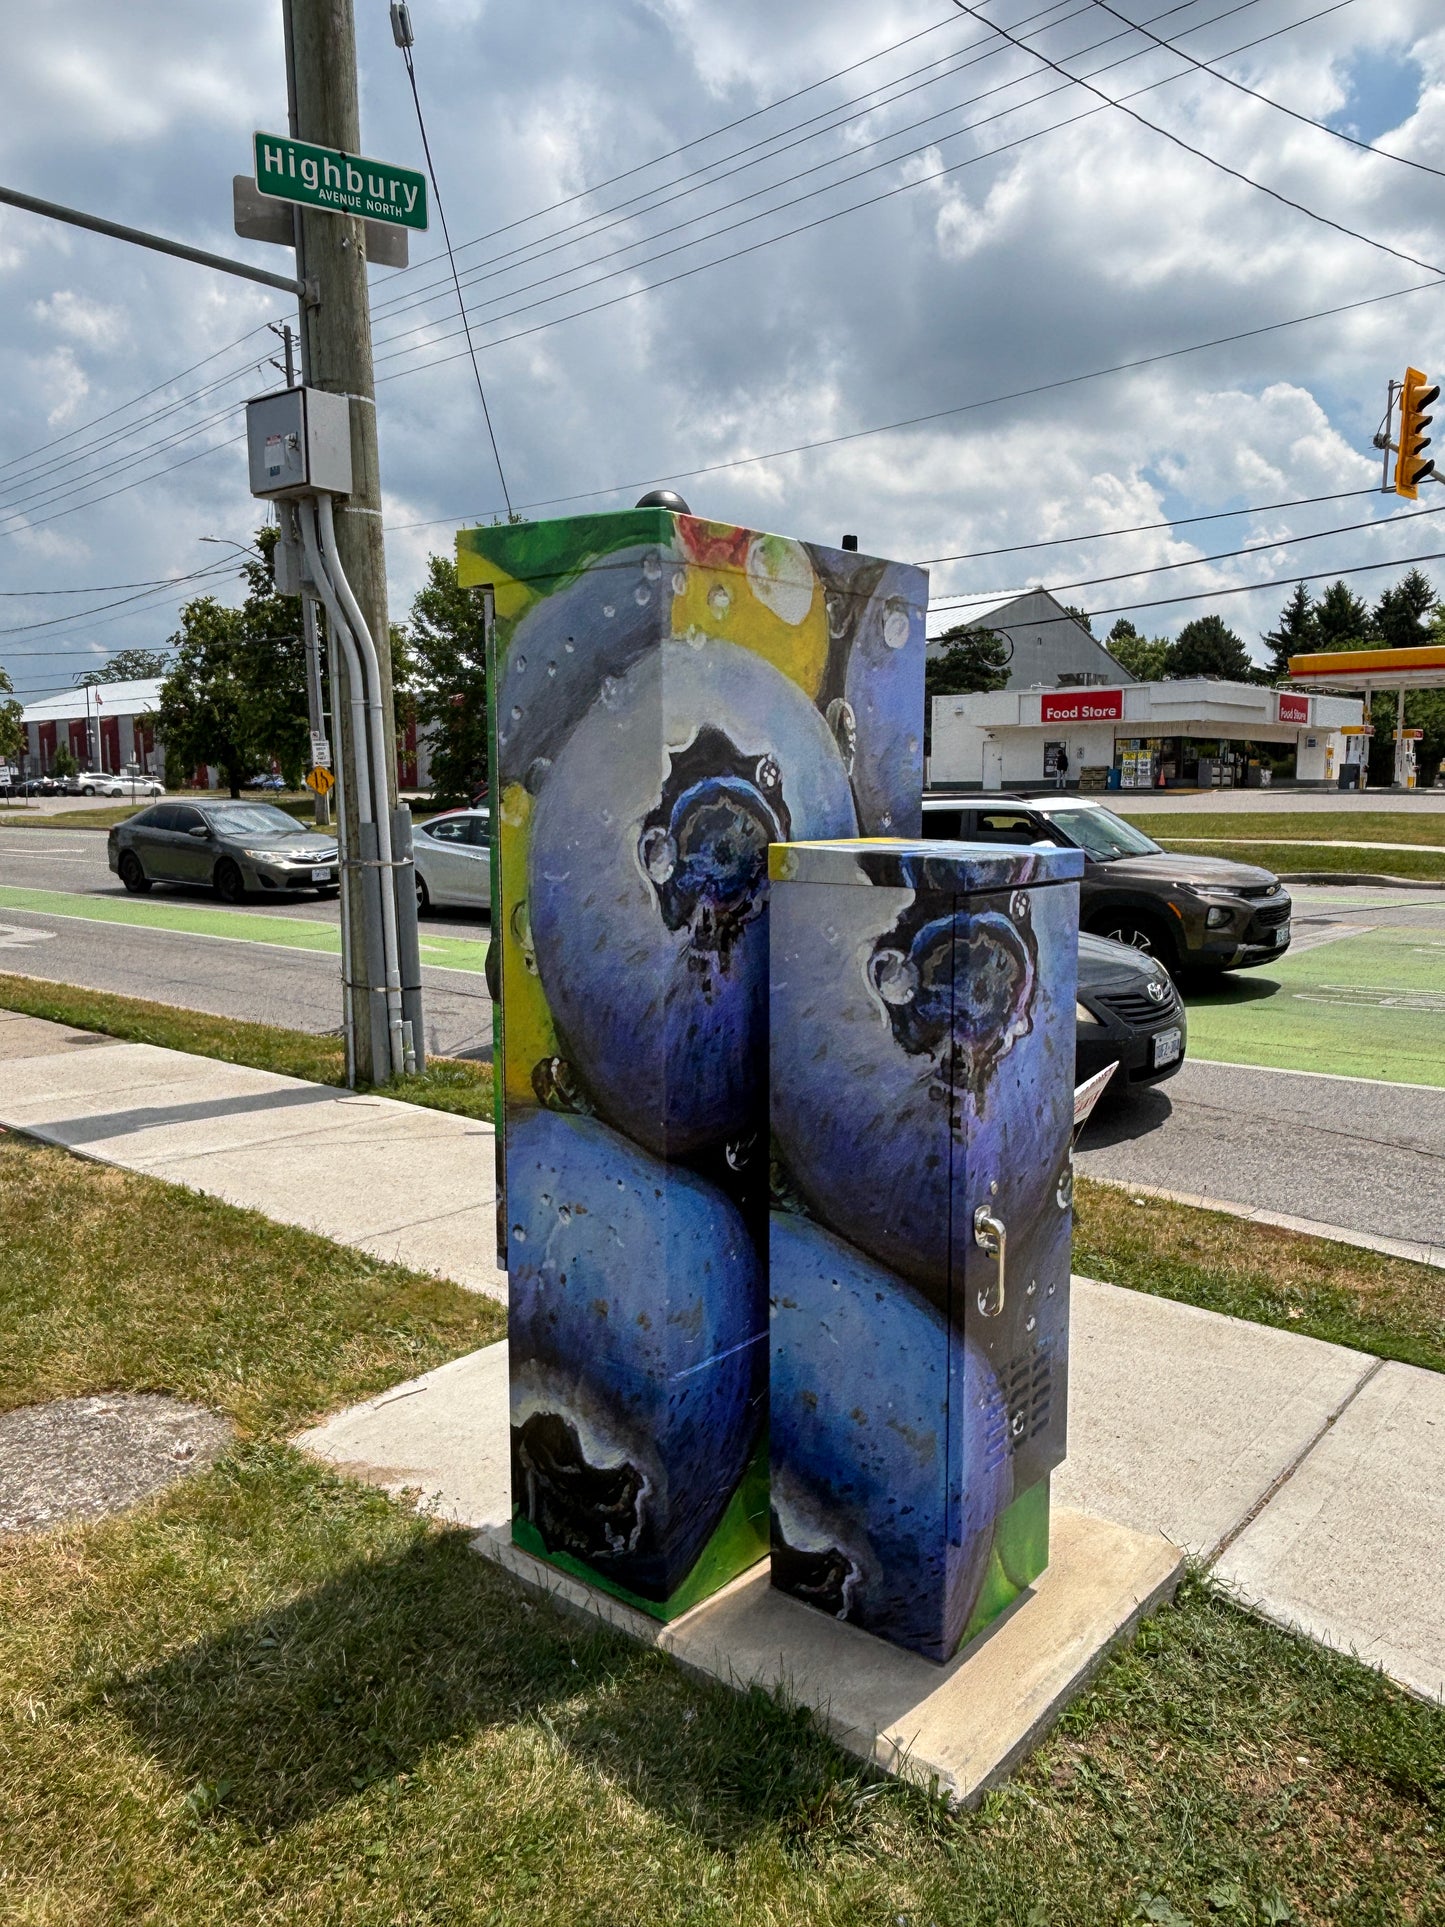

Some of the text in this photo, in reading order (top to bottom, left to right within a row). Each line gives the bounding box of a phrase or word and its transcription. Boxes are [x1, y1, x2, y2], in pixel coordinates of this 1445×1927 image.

[264, 144, 418, 213] Highbury
[318, 188, 403, 218] AVENUE NORTH
[1046, 705, 1117, 719] Food Store
[1280, 707, 1306, 721] Food Store
